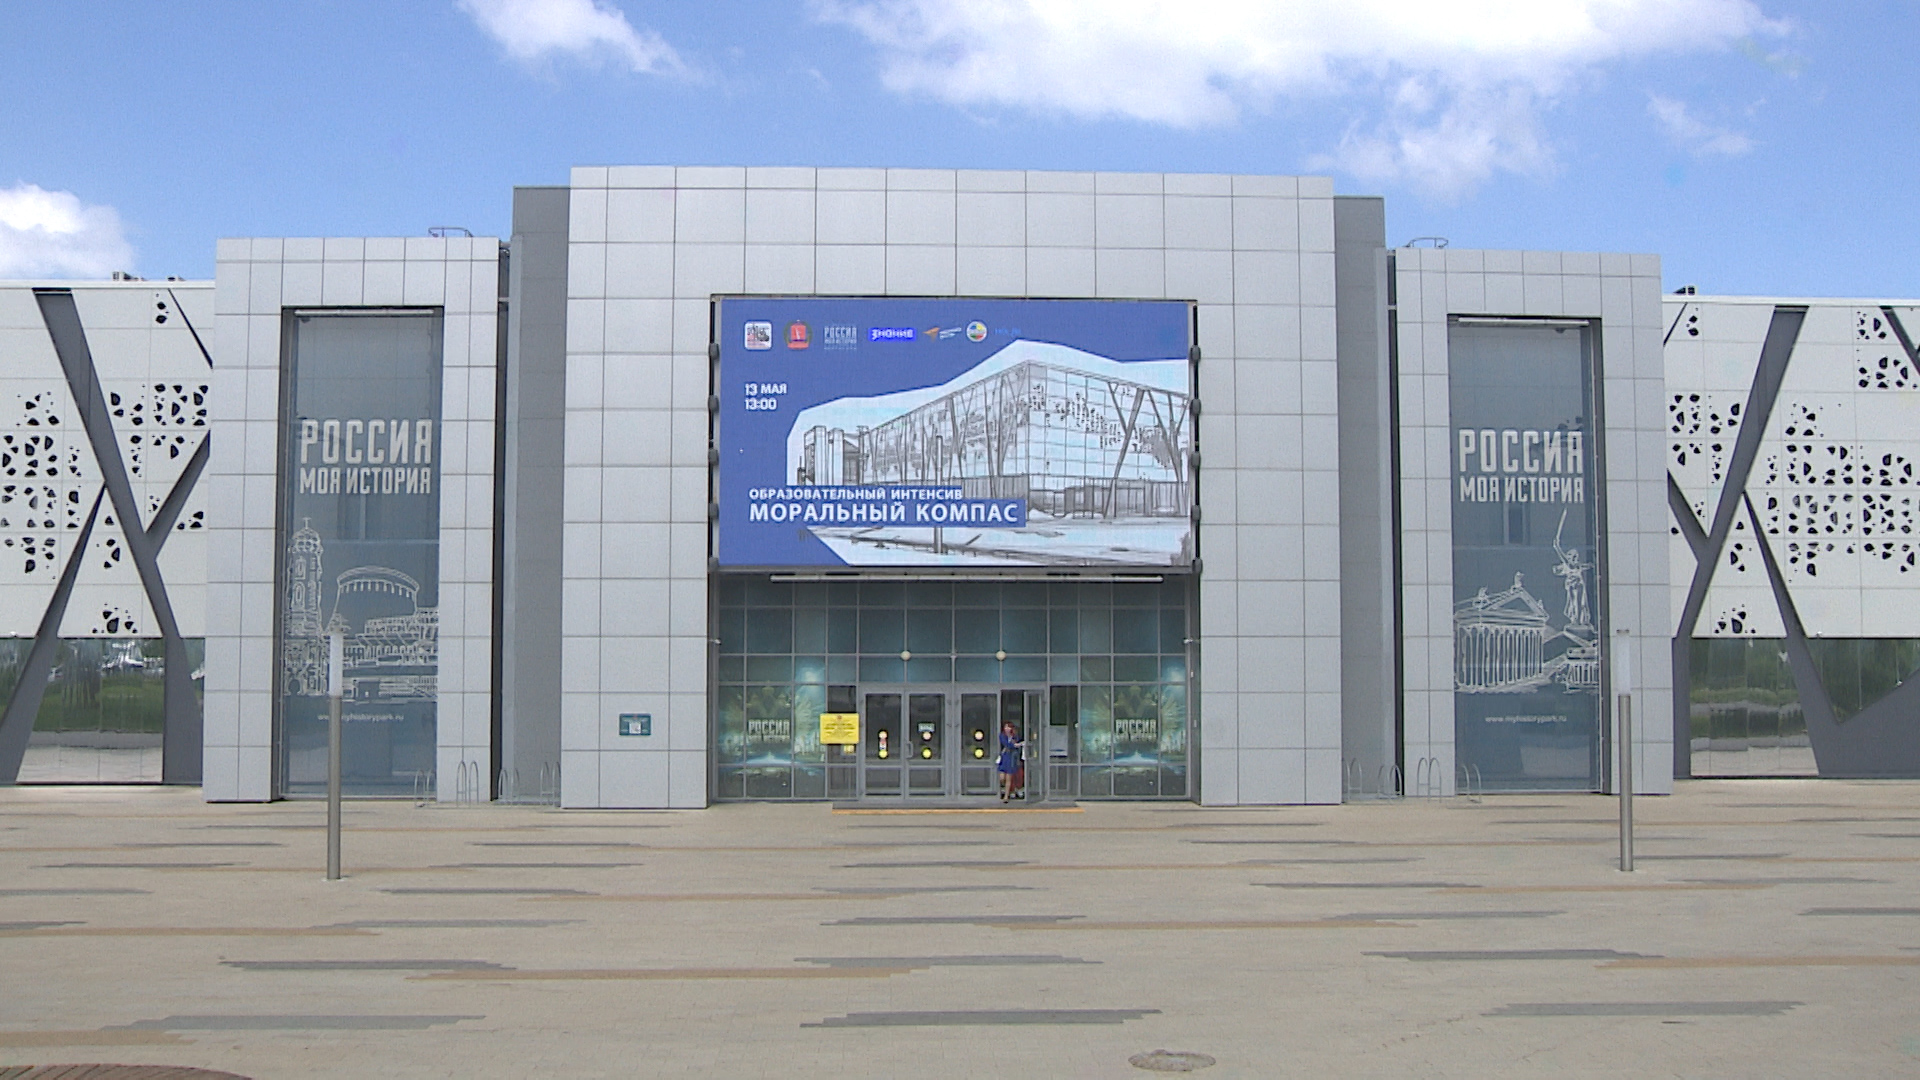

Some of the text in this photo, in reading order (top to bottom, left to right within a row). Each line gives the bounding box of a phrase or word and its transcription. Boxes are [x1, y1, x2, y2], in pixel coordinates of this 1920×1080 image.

[745, 383, 787, 396] 13 МАЯ
[745, 397, 777, 410] 13:00
[301, 419, 432, 464] РОССИЯ
[1459, 429, 1583, 474] РОССИЯ
[300, 467, 431, 494] МОЯ ИСТОРИЯ
[1460, 476, 1584, 503] МОЯ ИСТОРИЯ
[749, 487, 963, 500] ОБРАЗОВАТЕЛЬНЫЙ ИНТЕНСИВ
[750, 501, 1018, 522] МОРАЛЬНЫЙ КОМПАС
[748, 719, 790, 735] РОССИЯ
[1115, 719, 1157, 734] РОССИЯ
